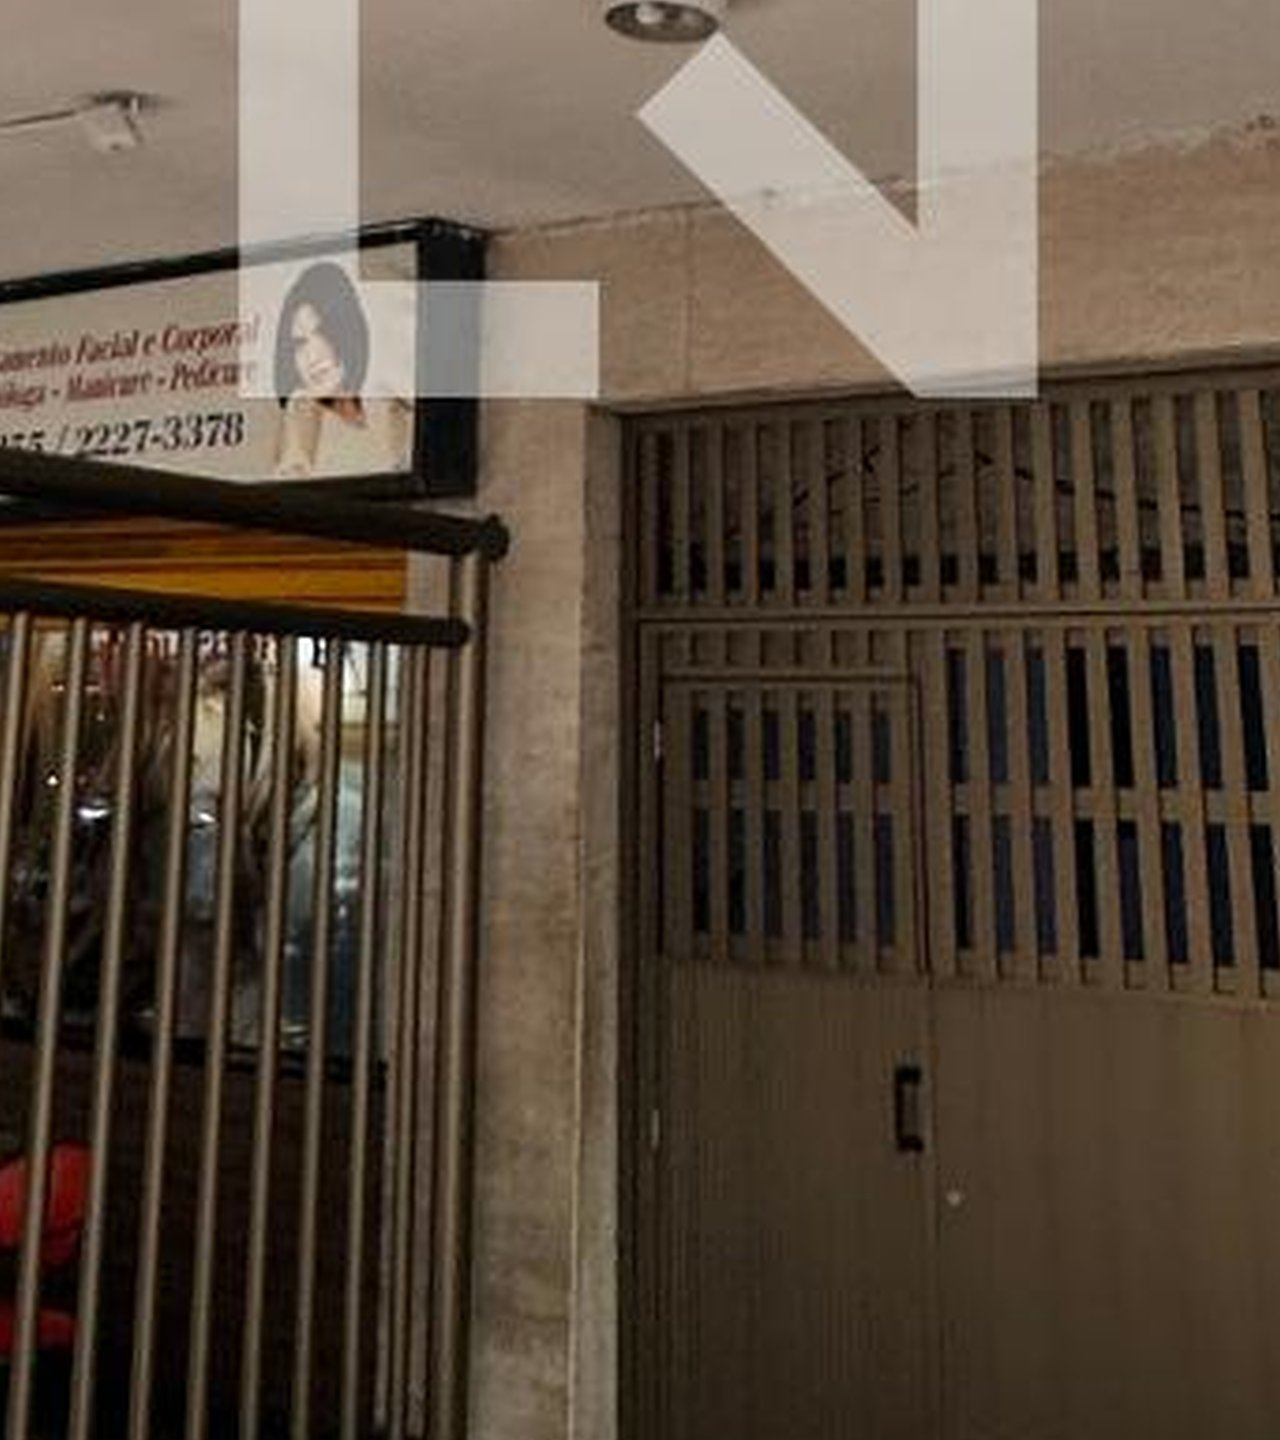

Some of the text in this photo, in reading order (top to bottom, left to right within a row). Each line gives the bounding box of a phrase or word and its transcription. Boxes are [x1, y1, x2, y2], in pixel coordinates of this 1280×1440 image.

[75, 329, 139, 369] Facial
[142, 334, 156, 355] e
[74, 410, 246, 459] 2227-3378
